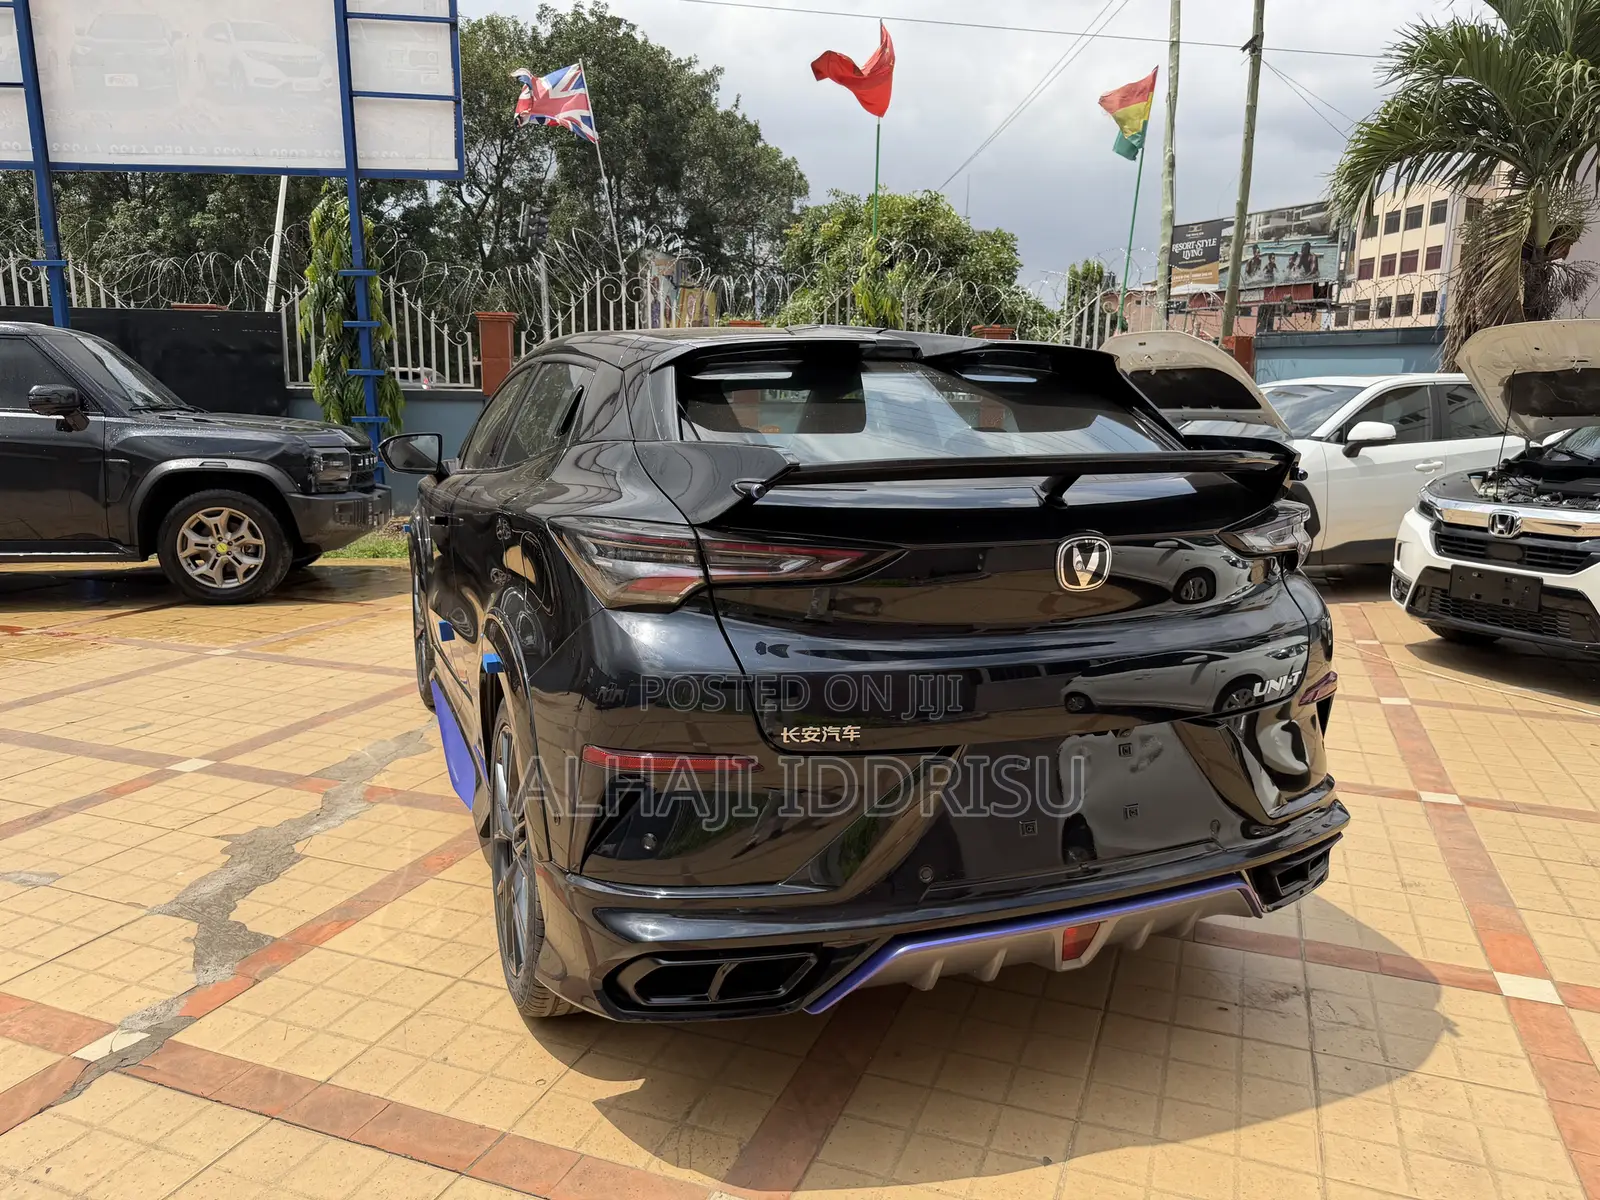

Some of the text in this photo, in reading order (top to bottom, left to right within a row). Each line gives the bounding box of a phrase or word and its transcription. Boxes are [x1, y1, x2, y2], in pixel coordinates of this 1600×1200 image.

[1182, 248, 1203, 260] LIVING
[781, 725, 861, 743] 长安汽车
